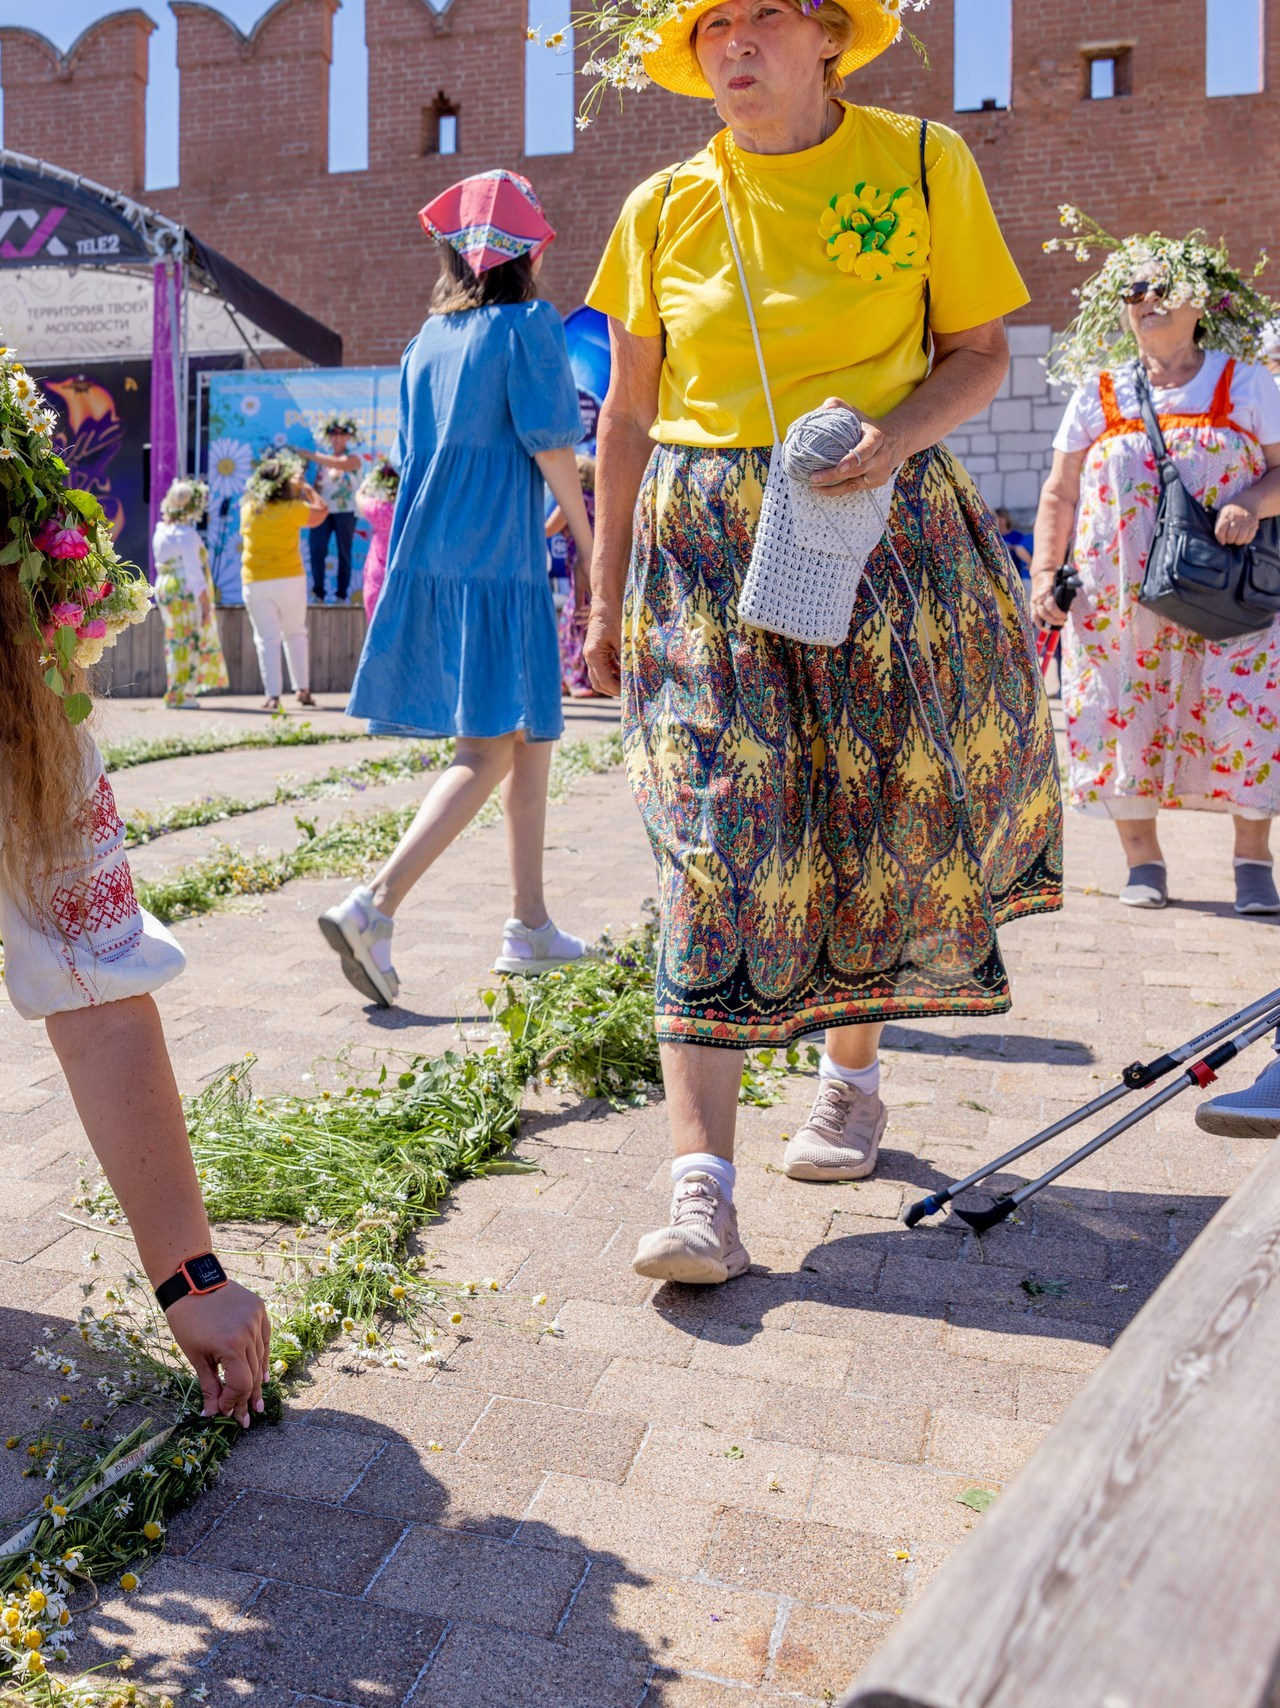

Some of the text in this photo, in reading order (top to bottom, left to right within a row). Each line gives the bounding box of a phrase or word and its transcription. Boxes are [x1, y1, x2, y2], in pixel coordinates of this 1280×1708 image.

[76, 234, 120, 255] TELE2
[27, 300, 148, 319] ТЕРРИТОРИЯ ТВОЕЙ
[45, 319, 129, 334] МОЛОДОСТИ
